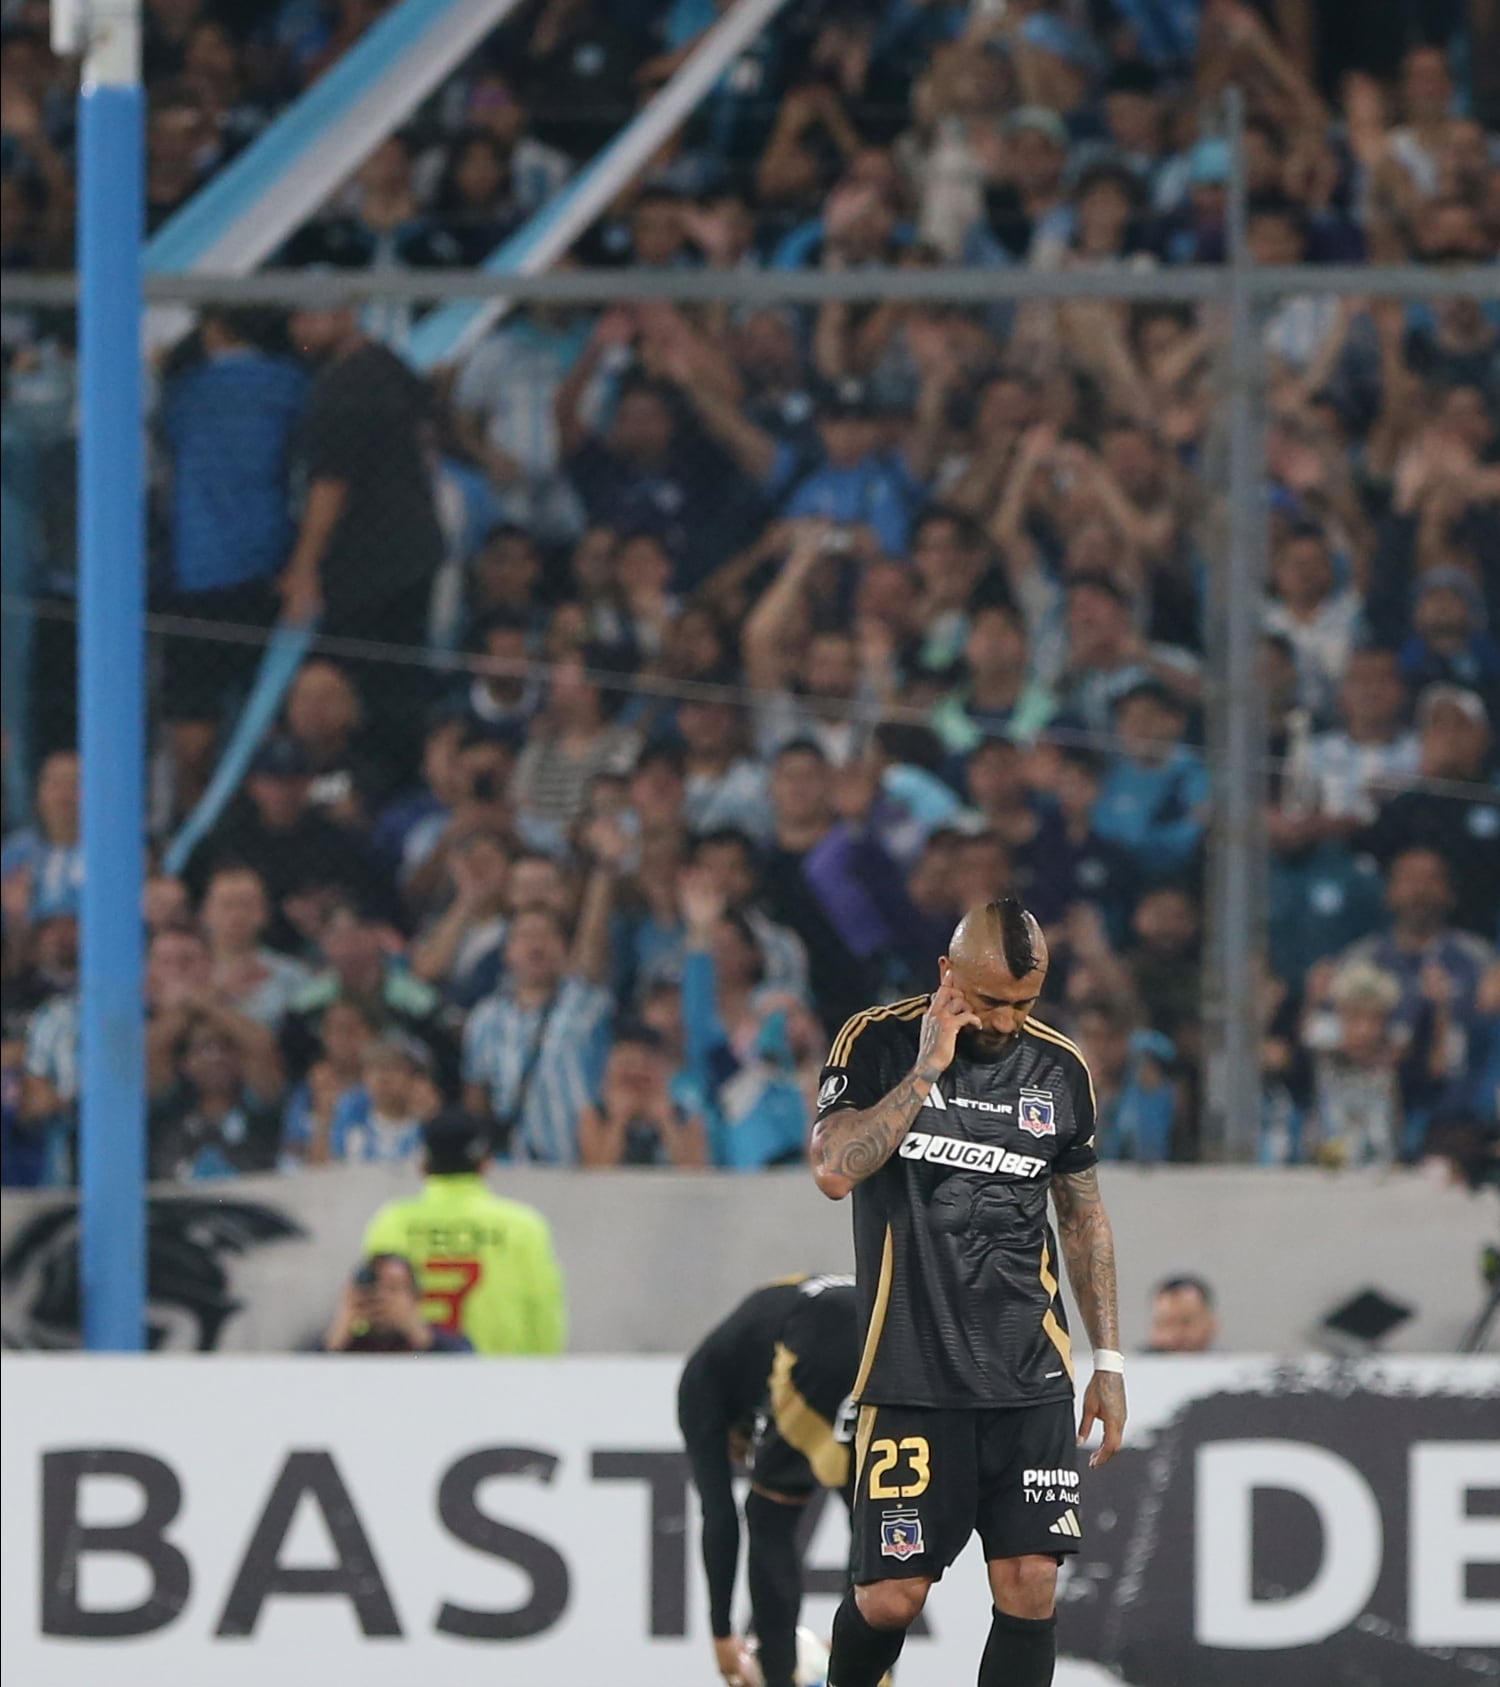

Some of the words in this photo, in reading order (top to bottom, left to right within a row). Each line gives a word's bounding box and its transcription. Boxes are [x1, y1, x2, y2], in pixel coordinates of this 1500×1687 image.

[948, 1097, 1013, 1115] JETOUR
[869, 1436, 931, 1500] 23
[1023, 1468, 1080, 1488] PHILIP
[1023, 1488, 1043, 1504] TV
[1044, 1488, 1056, 1502] &
[1058, 1488, 1080, 1505] Aud
